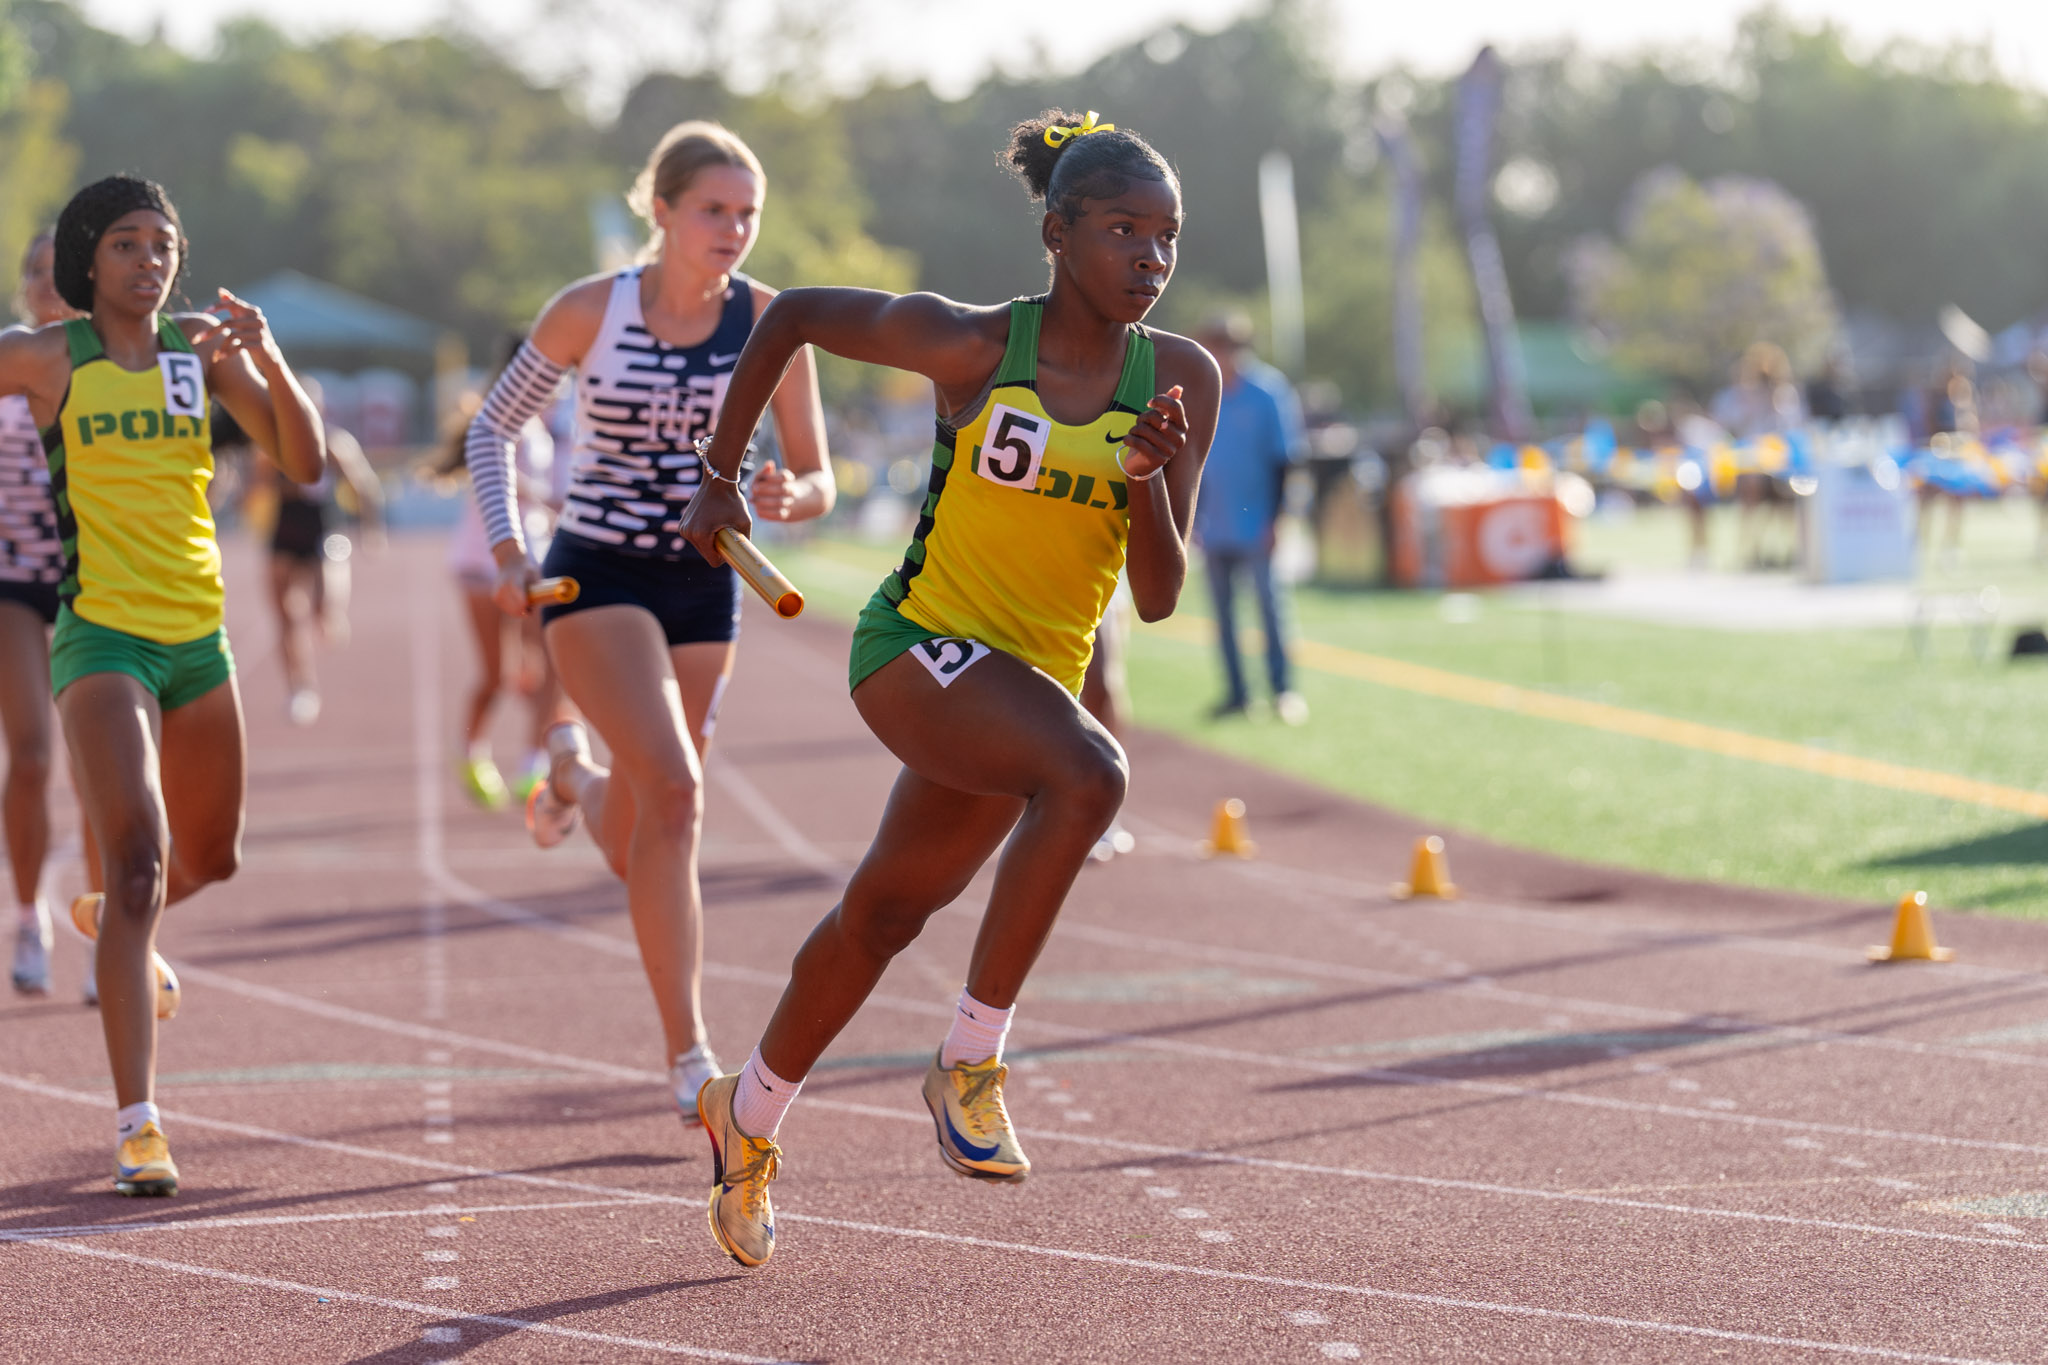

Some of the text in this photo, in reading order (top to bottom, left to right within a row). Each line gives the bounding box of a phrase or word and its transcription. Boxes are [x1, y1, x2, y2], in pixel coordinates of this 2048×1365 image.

[168, 359, 198, 410] 5
[988, 411, 1040, 482] 5
[920, 638, 974, 675] 5
